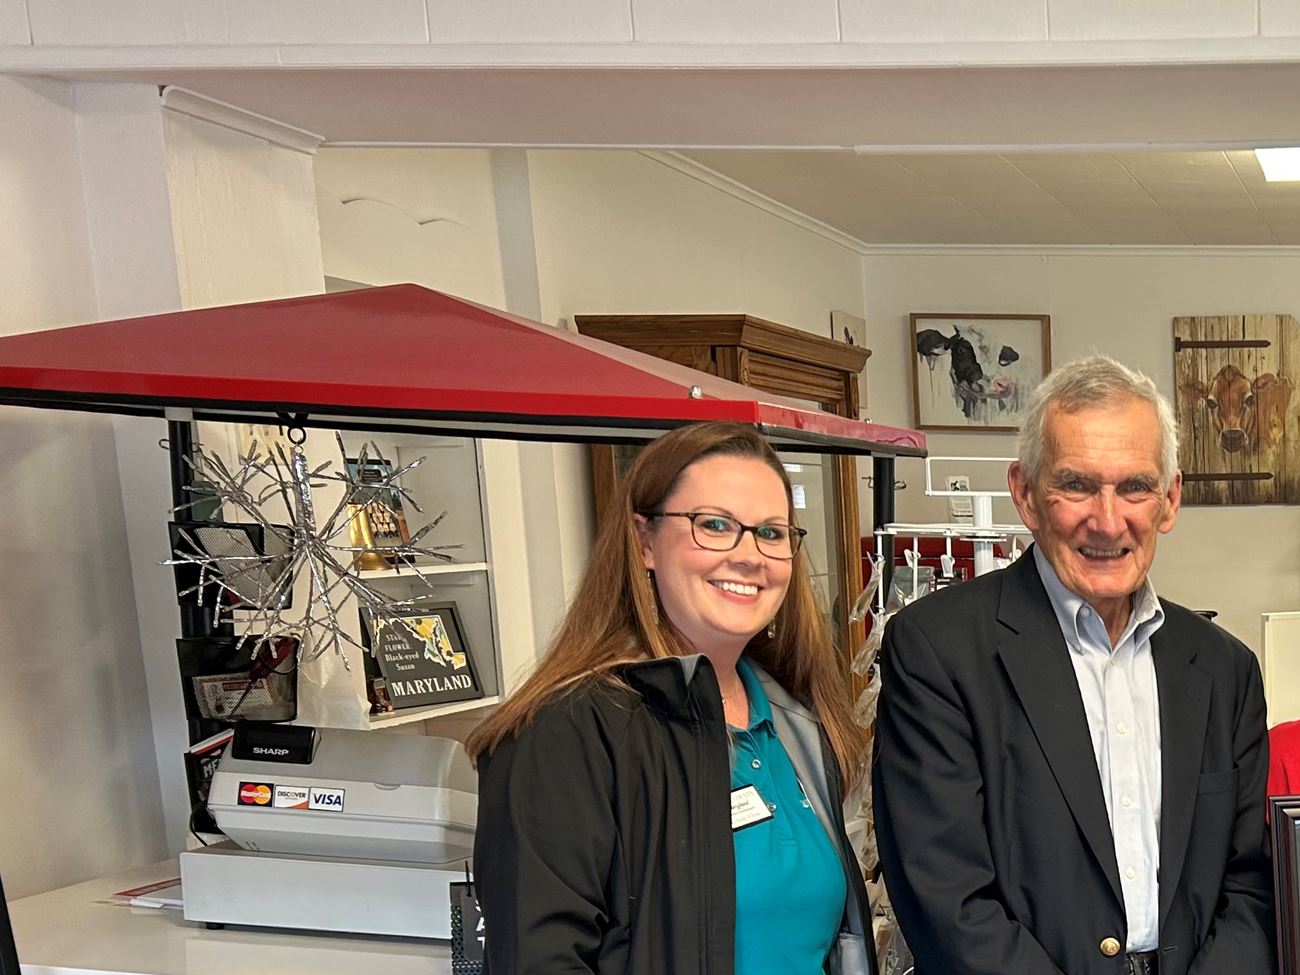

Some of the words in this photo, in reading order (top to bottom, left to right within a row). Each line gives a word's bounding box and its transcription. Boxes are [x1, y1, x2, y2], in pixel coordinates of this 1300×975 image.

[384, 652, 420, 662] Black-eyed
[395, 663, 416, 671] Susan
[391, 674, 473, 697] MARYLAND
[252, 746, 290, 756] SHARP
[277, 790, 306, 798] DISCOVER
[312, 793, 342, 806] VISA
